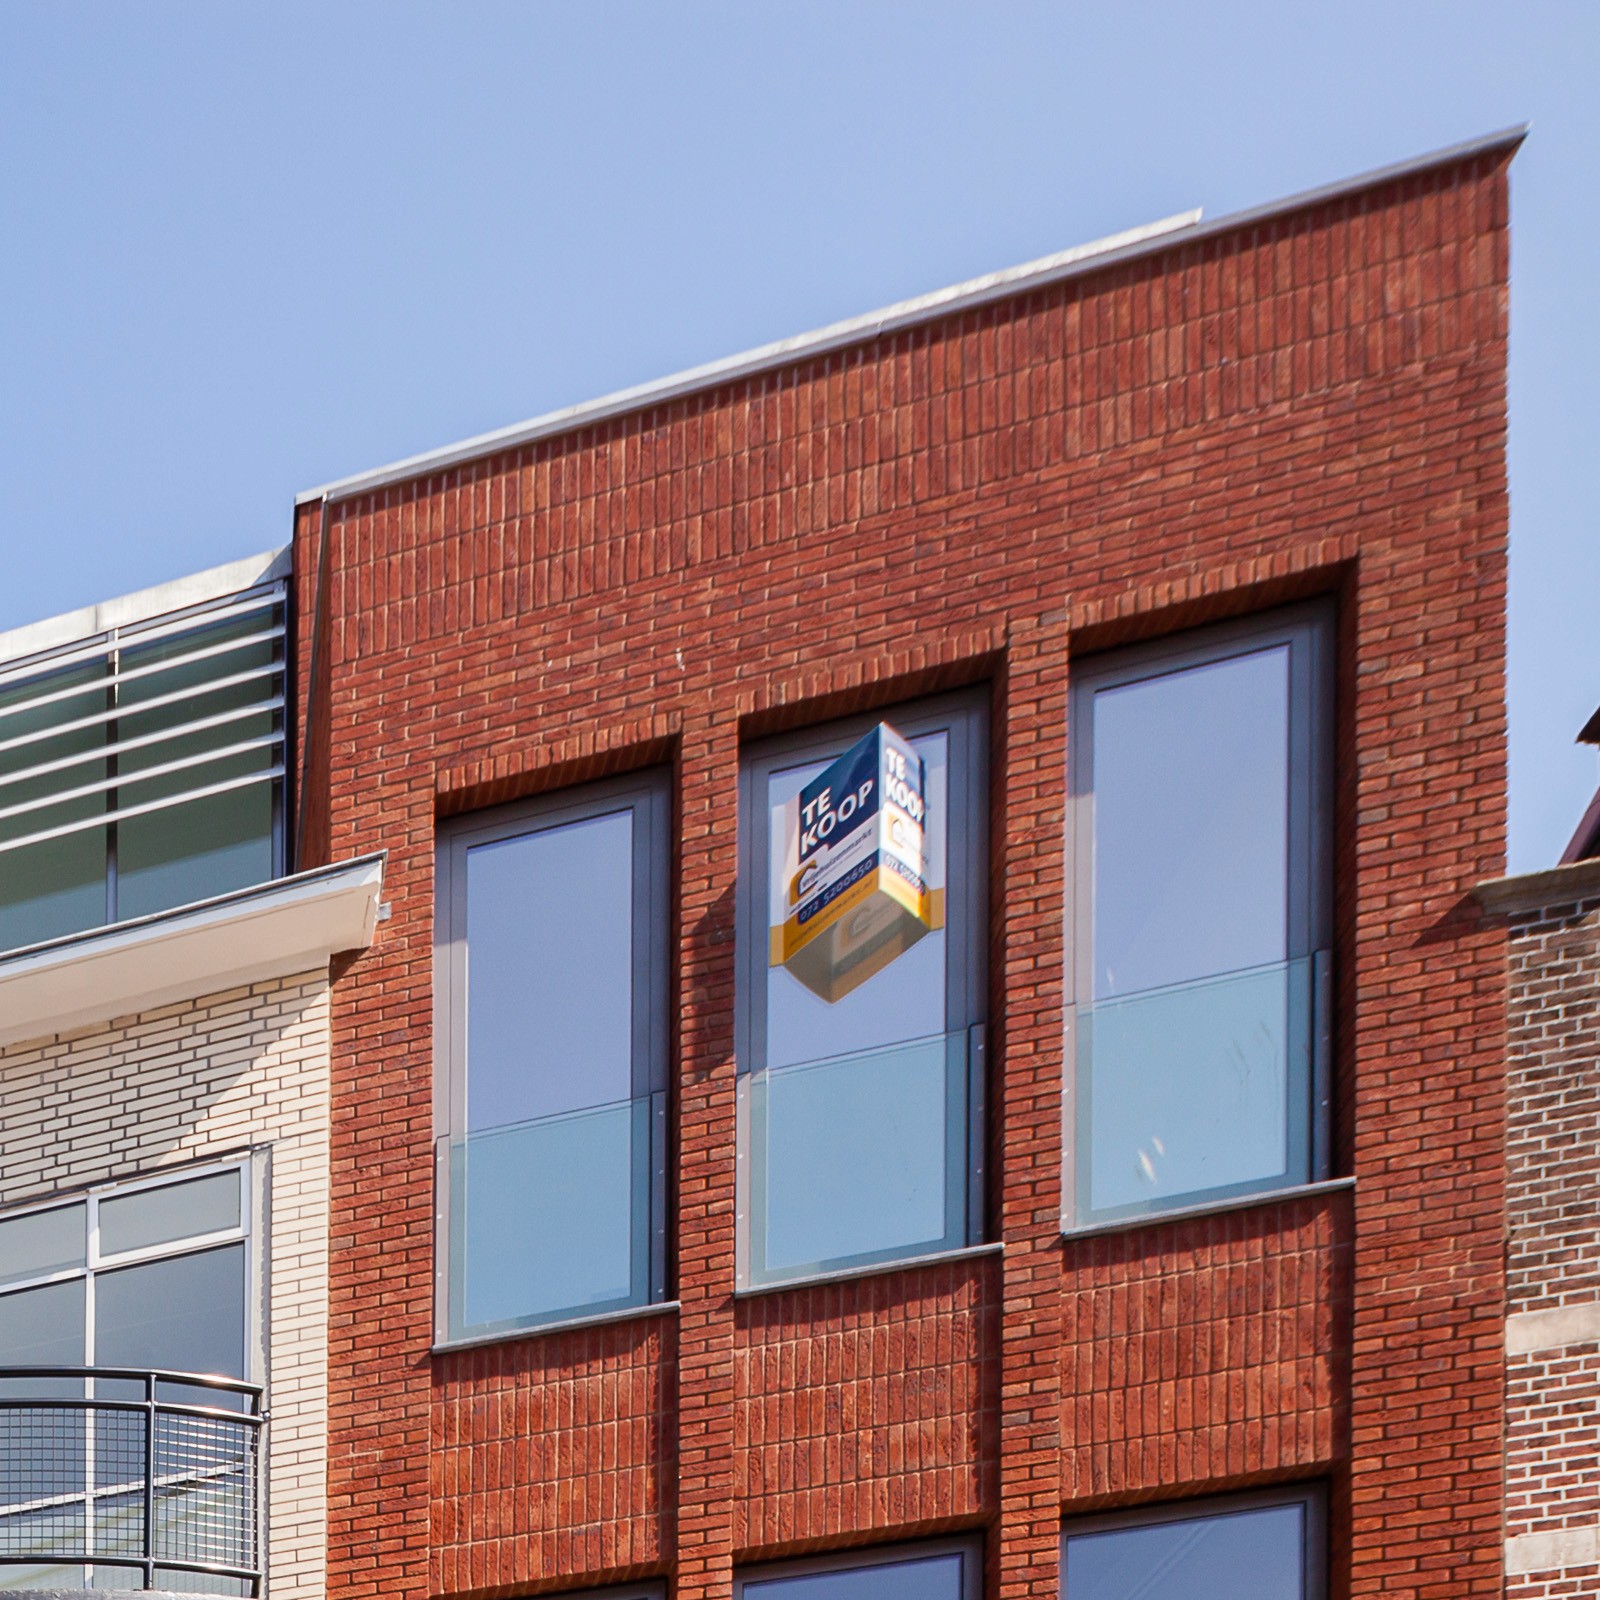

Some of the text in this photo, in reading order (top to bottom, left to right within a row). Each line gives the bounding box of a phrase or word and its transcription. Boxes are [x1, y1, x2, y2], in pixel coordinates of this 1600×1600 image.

[886, 747, 906, 779] TE
[801, 779, 874, 856] KOOP
[802, 786, 831, 827] TE
[800, 902, 820, 922] 072
[823, 858, 874, 905] 5200650
